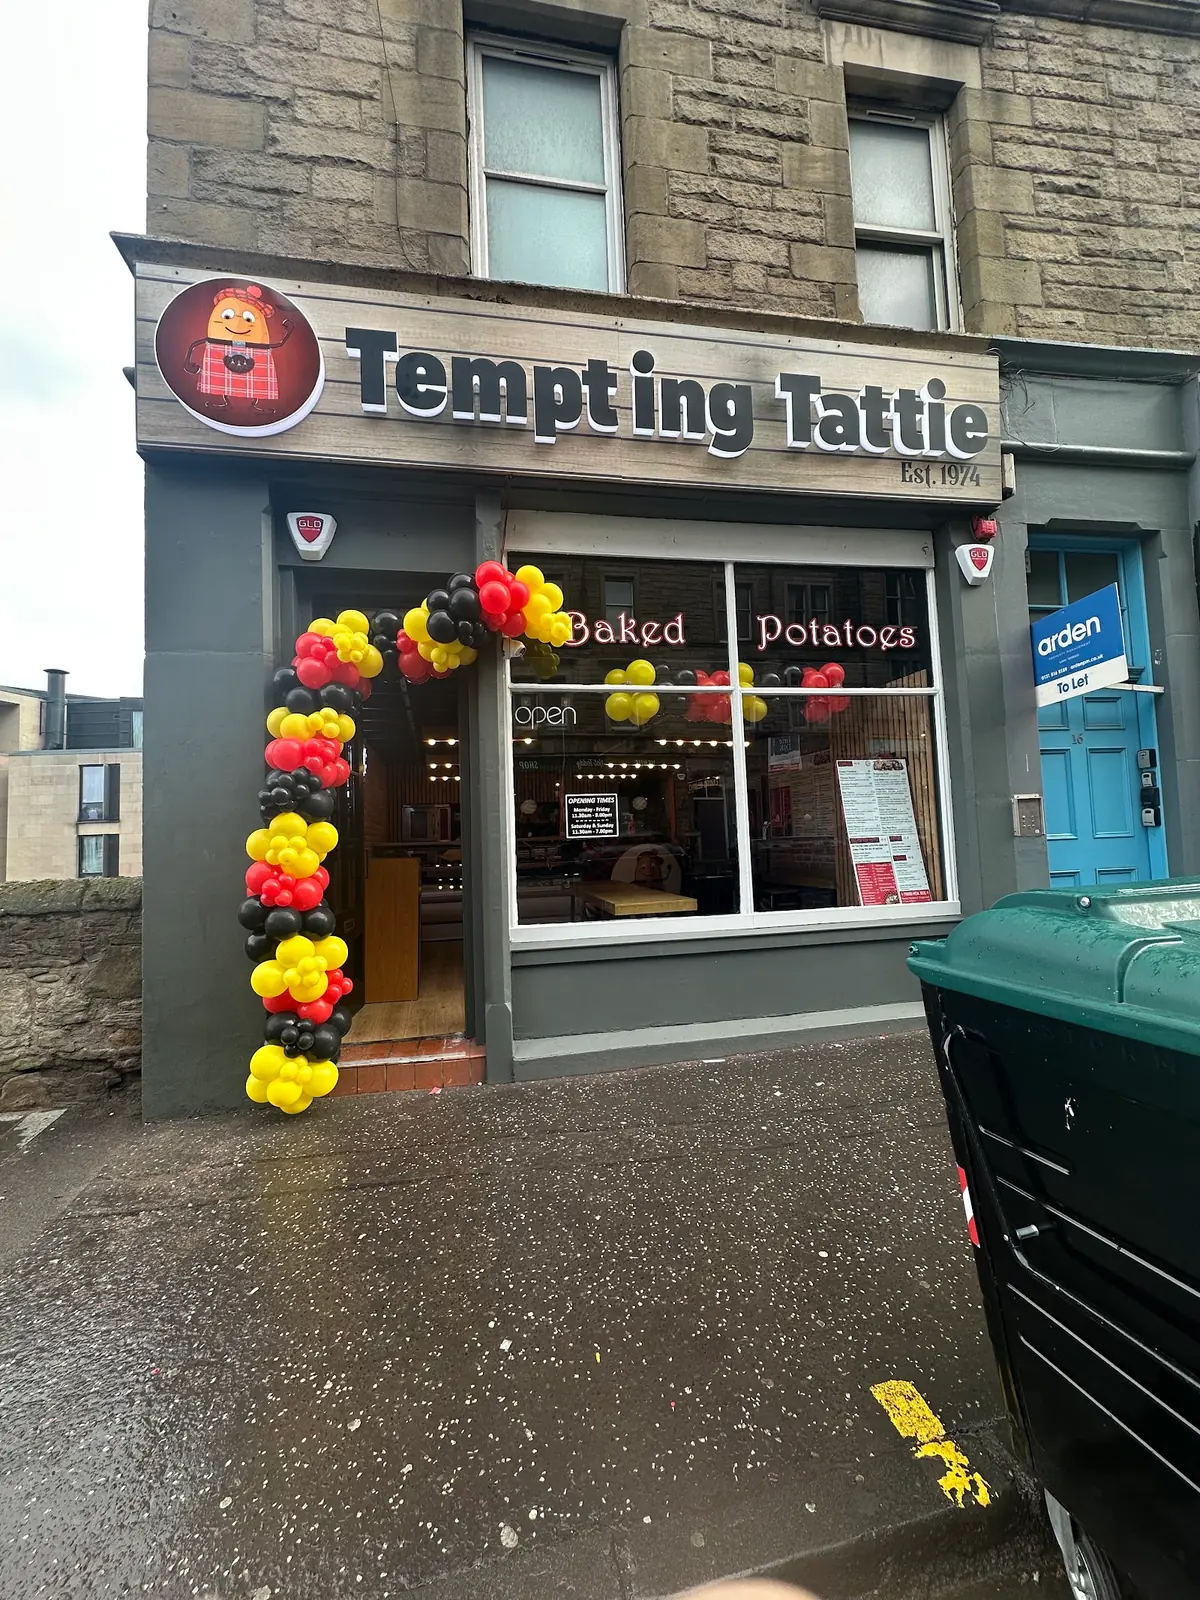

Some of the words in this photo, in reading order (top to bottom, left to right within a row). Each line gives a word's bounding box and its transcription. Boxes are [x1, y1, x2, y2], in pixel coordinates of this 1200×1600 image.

[345, 327, 754, 458] Tempting
[775, 372, 988, 459] Tattie
[901, 462, 936, 488] Est.
[941, 464, 981, 486] 1974
[298, 519, 322, 528] GLD
[568, 610, 687, 648] Baked
[756, 613, 916, 651] Potatoes
[1038, 616, 1101, 656] arden
[1057, 681, 1070, 694] To
[1071, 673, 1089, 690] Let
[515, 706, 577, 730] open
[1071, 732, 1084, 745] 16
